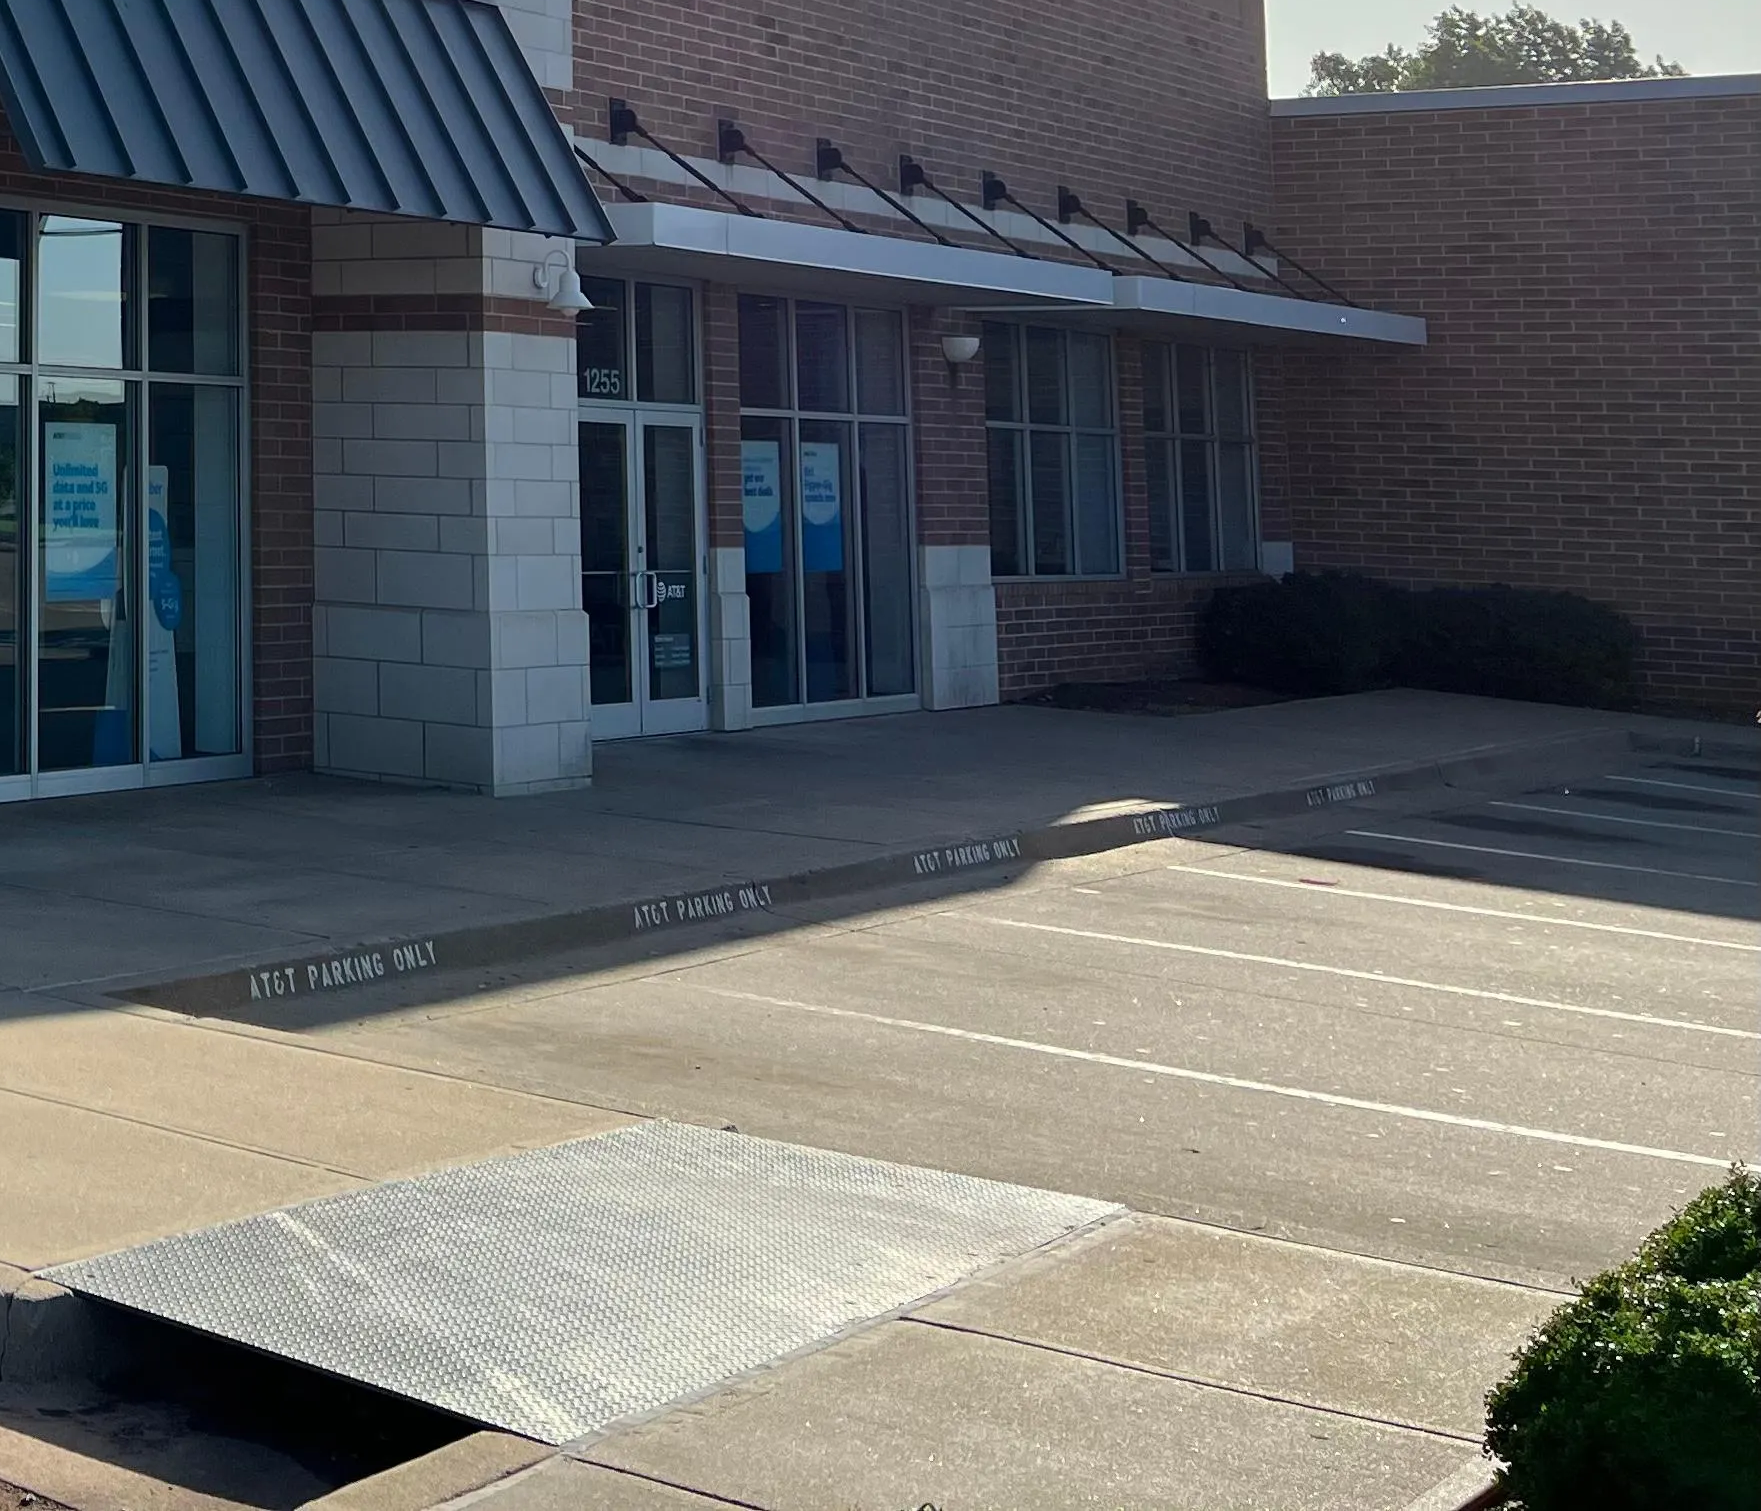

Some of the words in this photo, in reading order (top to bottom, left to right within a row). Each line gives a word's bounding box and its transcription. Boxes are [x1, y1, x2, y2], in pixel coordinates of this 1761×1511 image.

[583, 367, 620, 394] 1255
[53, 463, 99, 477] Unlimited
[53, 481, 74, 494] data
[76, 482, 94, 494] and
[95, 482, 108, 495] 5G
[53, 500, 63, 510] at
[65, 502, 71, 510] a
[73, 499, 96, 516] price
[79, 516, 99, 528] love
[667, 585, 686, 598] AT&T
[945, 843, 990, 867] PARKING
[993, 838, 1021, 859] ONLY
[676, 892, 734, 921] PARKING
[738, 885, 772, 909] ONLY
[250, 967, 295, 1000] AT&T
[307, 952, 384, 990] PARKING
[393, 940, 437, 971] ONLY
